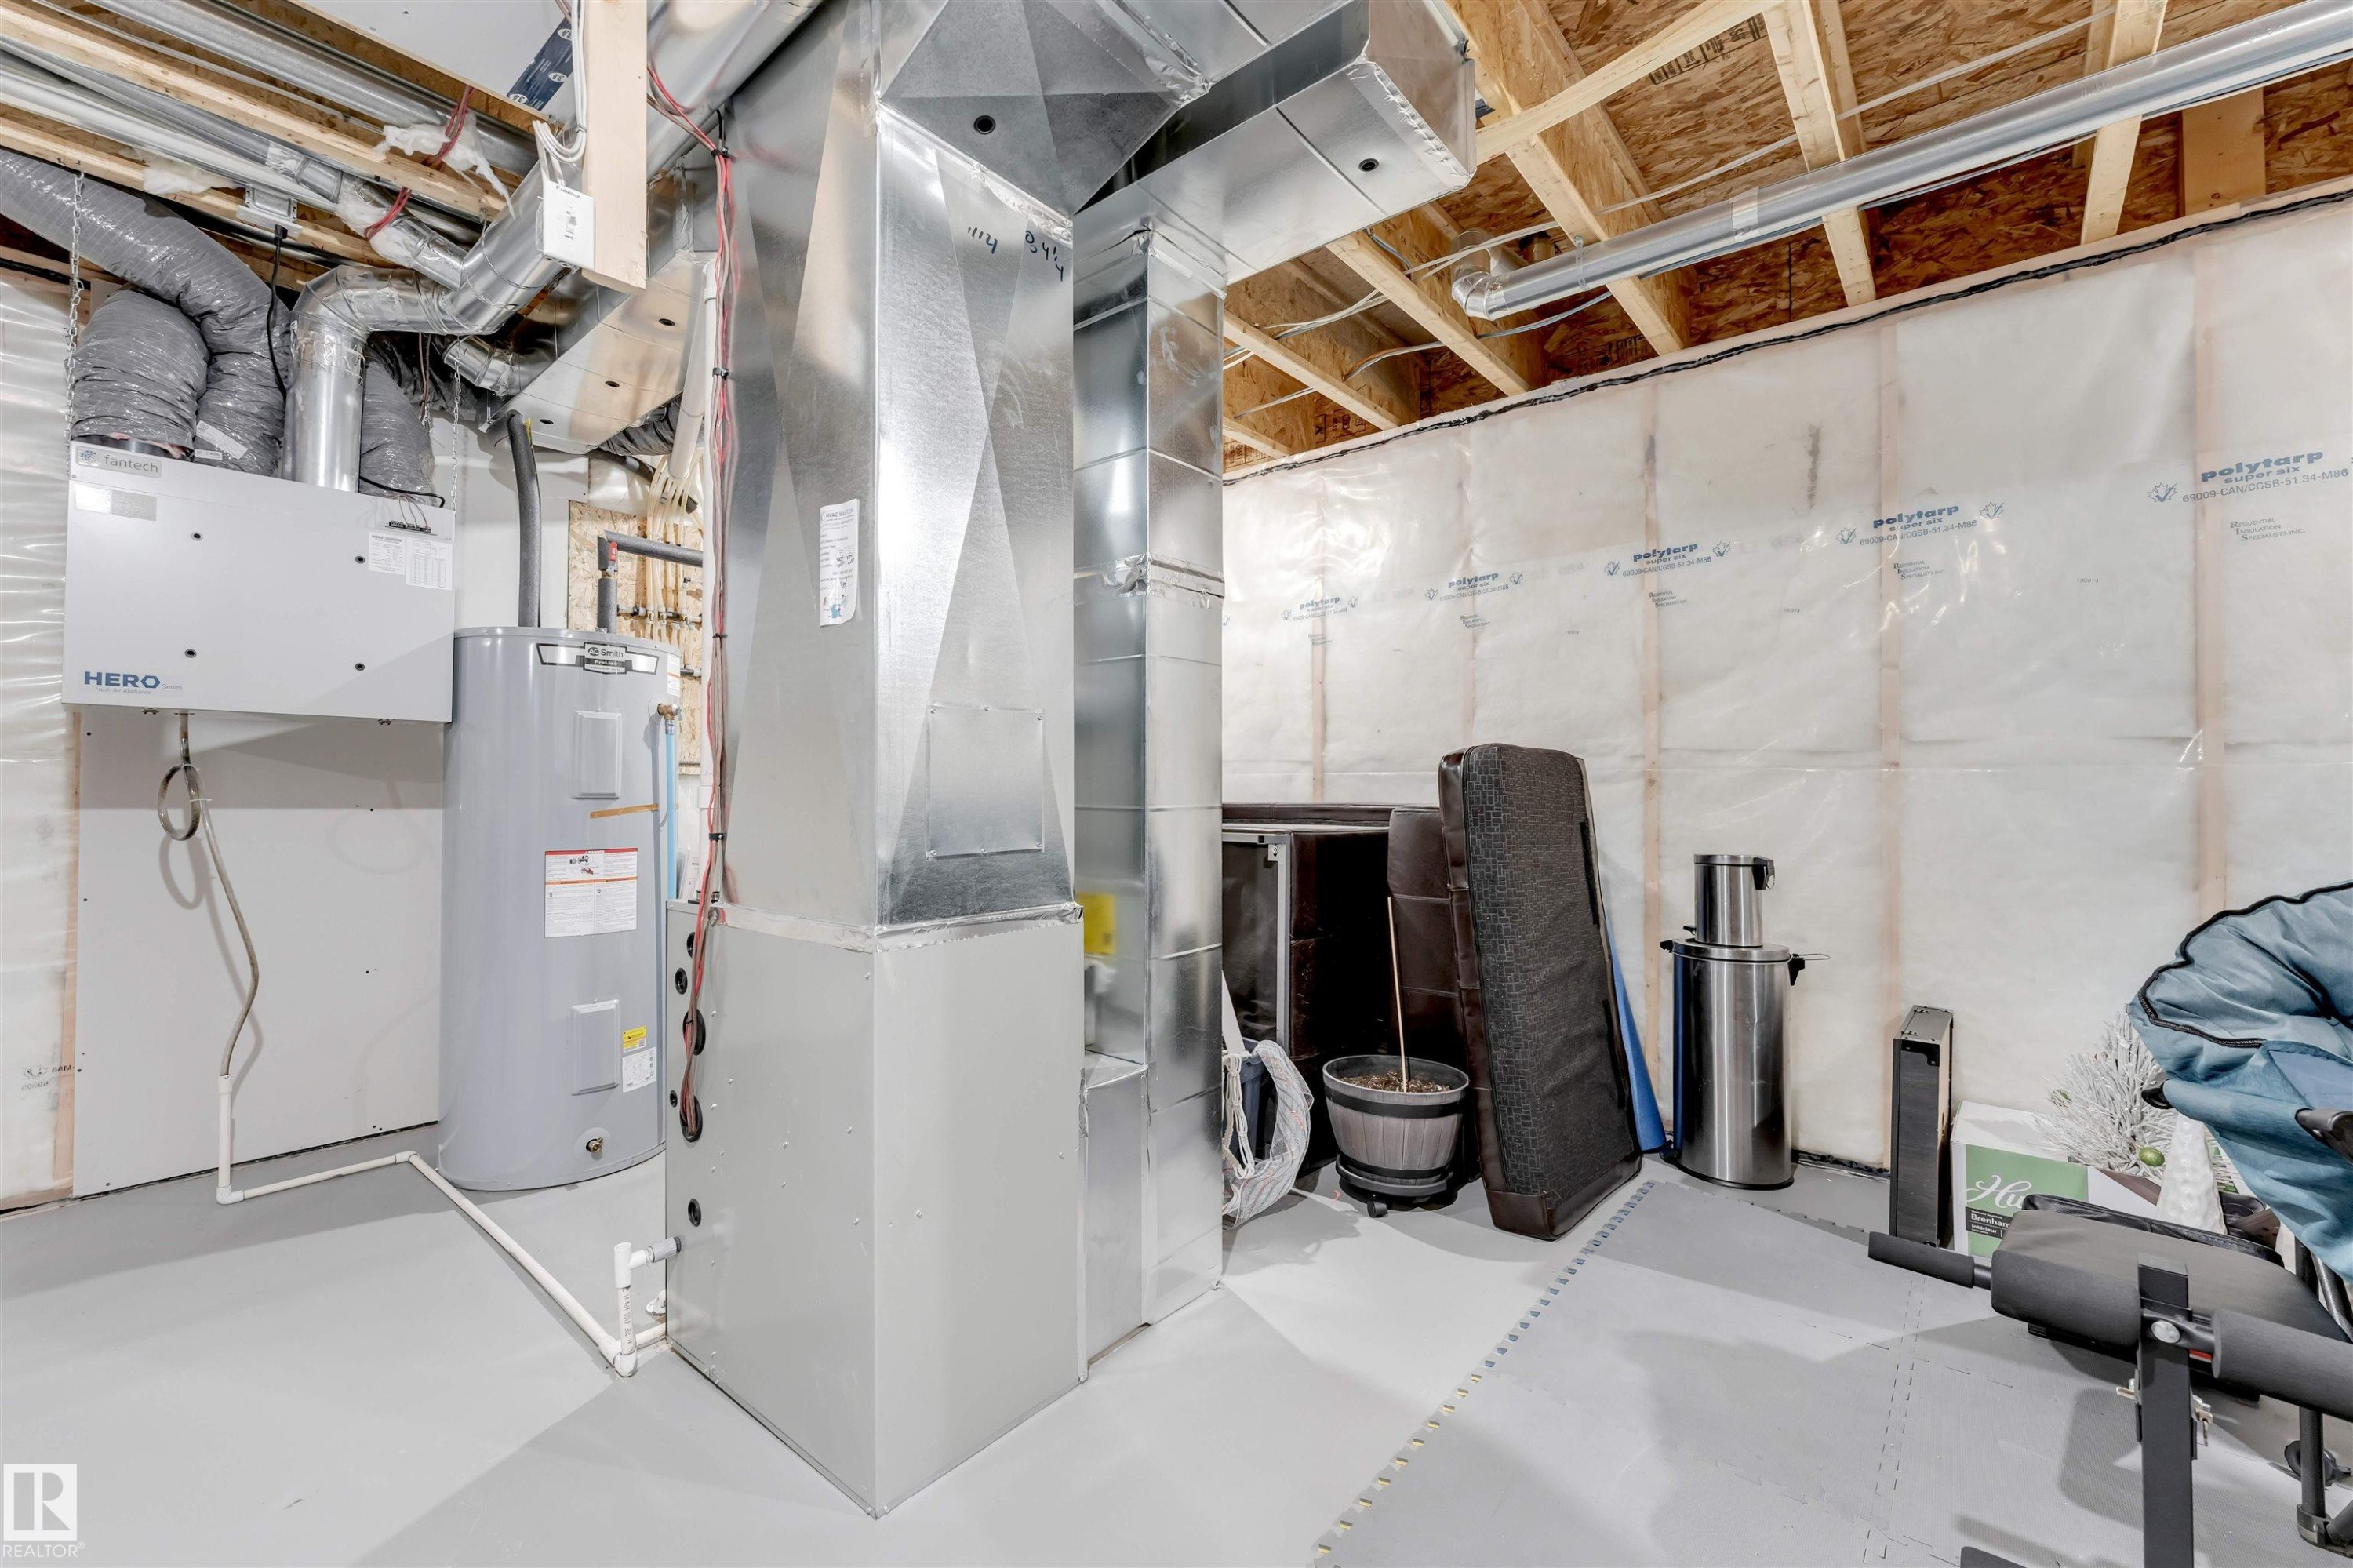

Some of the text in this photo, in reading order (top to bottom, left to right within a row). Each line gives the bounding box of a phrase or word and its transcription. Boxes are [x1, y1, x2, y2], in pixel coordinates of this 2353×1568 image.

[104, 454, 158, 473] fantech
[2200, 451, 2323, 482] polytarp
[2224, 465, 2300, 484] super six
[2182, 468, 2349, 503] 69009-CAN/CGSB-51.34-M86
[1873, 505, 1959, 529] polytarp
[1633, 544, 1698, 562] polytarp
[1449, 573, 1499, 588] polytarp
[1300, 597, 1340, 610] polytarp
[84, 671, 161, 689] HERO
